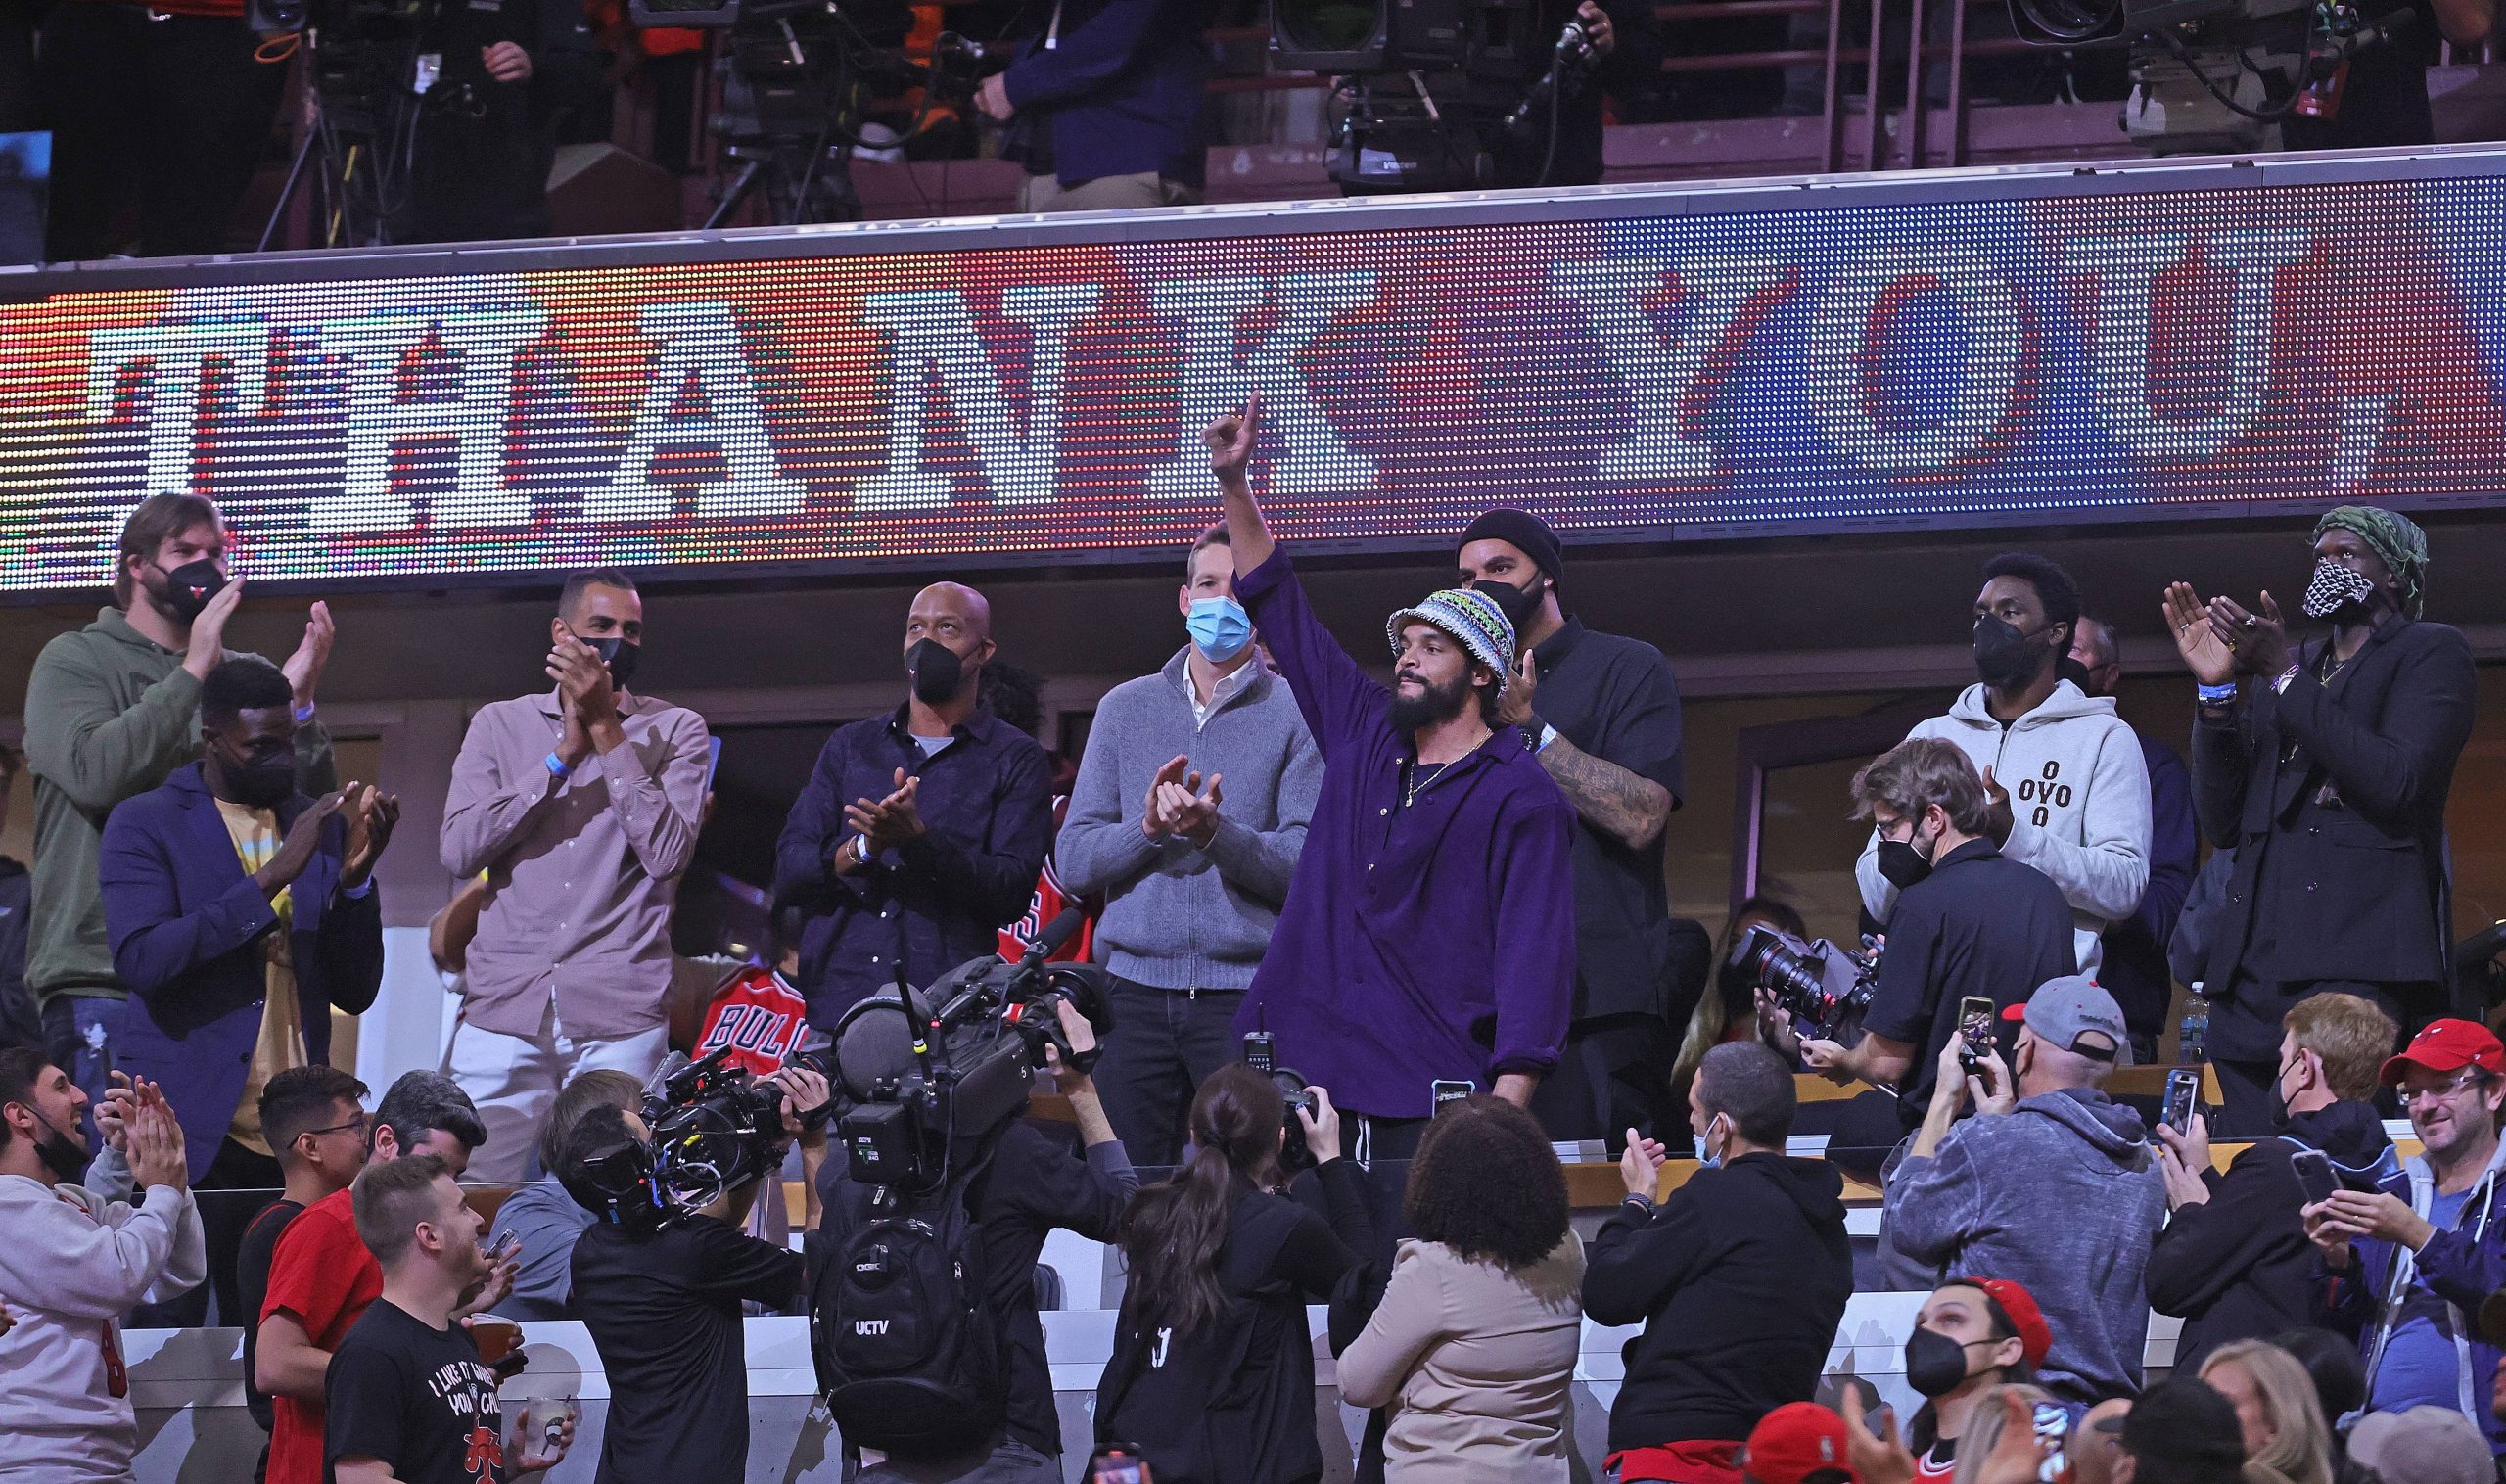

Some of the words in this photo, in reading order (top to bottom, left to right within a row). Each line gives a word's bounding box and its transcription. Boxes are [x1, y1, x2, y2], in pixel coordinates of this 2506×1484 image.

[85, 269, 1381, 535] THANK
[1552, 227, 2393, 489] YOU,
[855, 1320, 890, 1336] UCTV
[428, 1379, 441, 1398] I
[435, 1363, 462, 1392] LIKE
[447, 1392, 474, 1416] YOU
